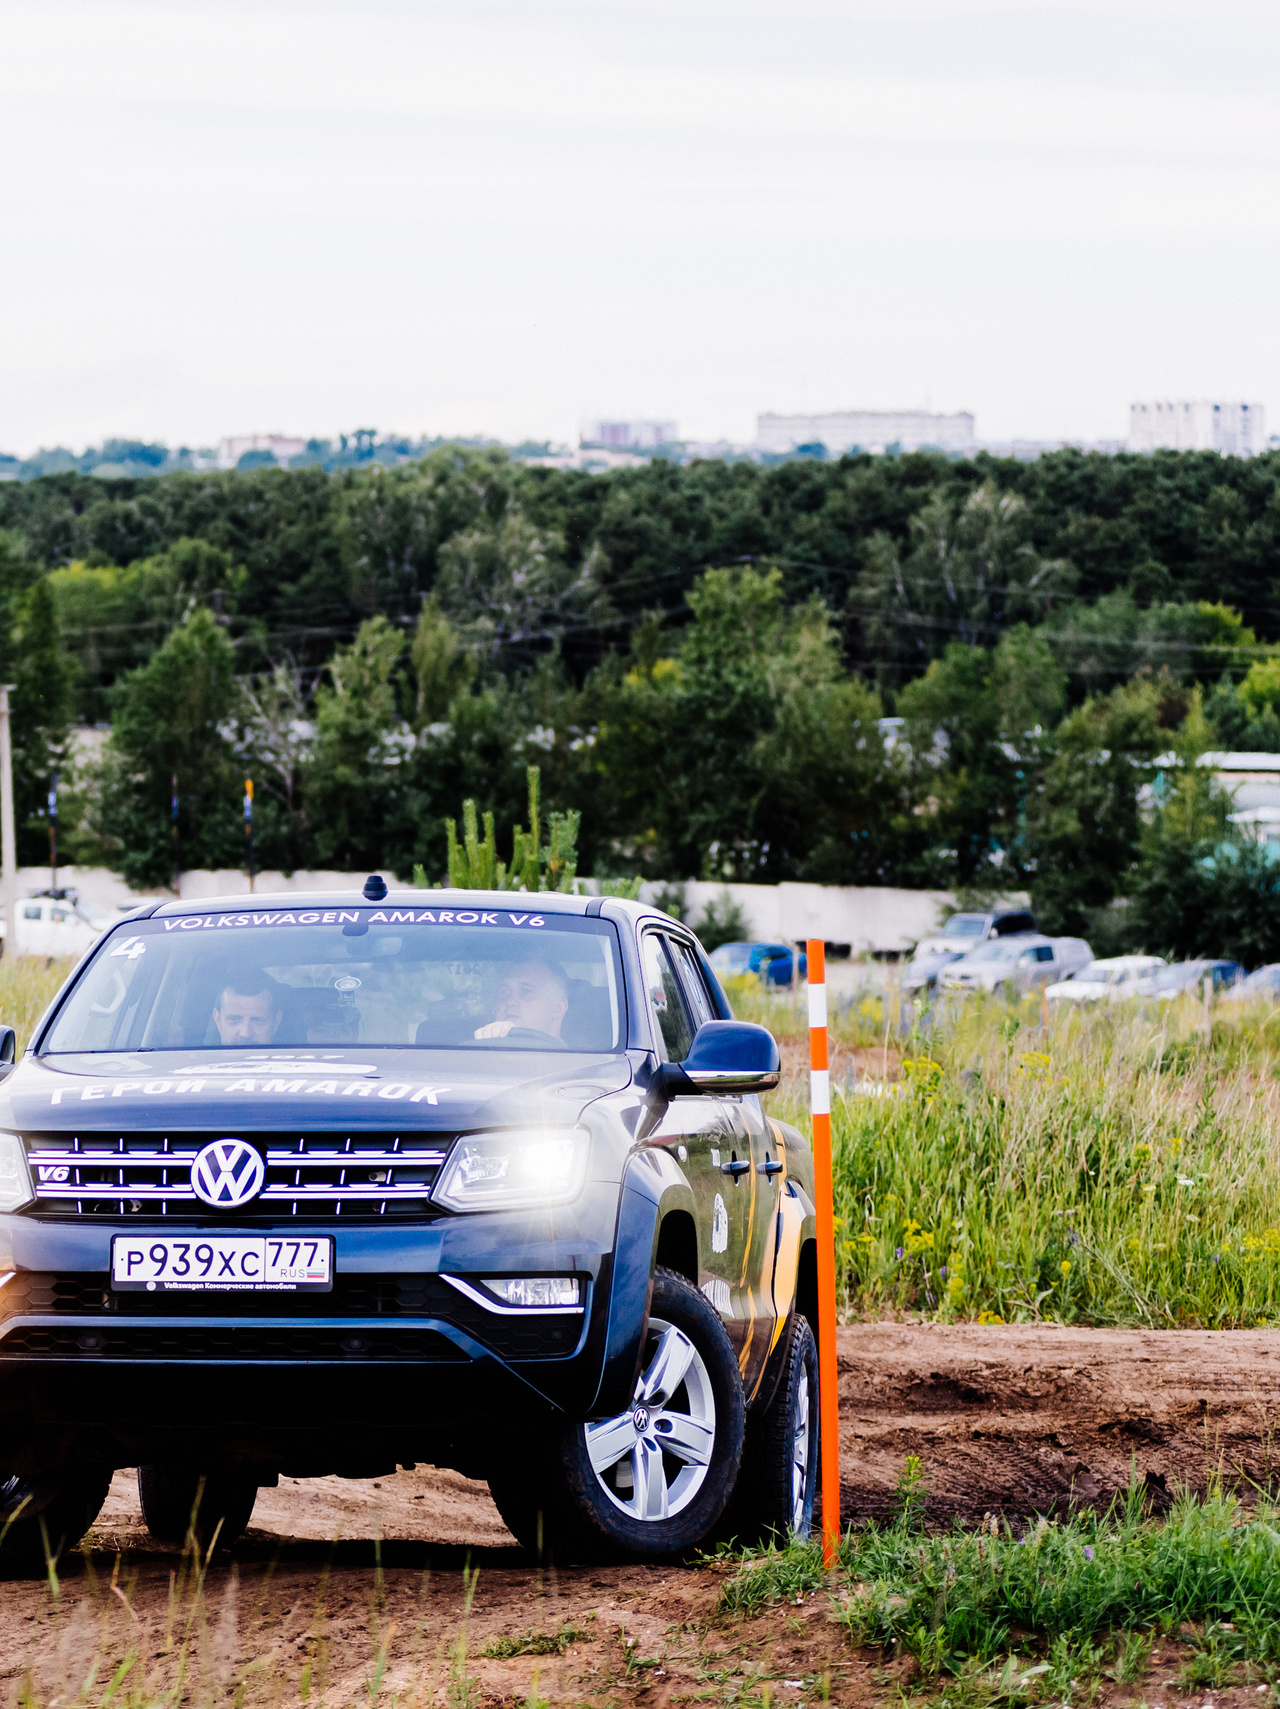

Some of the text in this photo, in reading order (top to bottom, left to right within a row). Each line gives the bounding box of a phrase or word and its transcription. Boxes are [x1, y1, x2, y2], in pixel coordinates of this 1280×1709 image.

[163, 911, 546, 931] VOLKSWAGEN AMAROK V6
[110, 936, 147, 960] 4
[224, 1077, 454, 1106] AMAROK
[38, 1165, 70, 1182] V6
[268, 1241, 319, 1268] 777
[280, 1268, 306, 1279] RUS
[164, 1281, 205, 1291] Volkswagen
[205, 1282, 255, 1291] Коммерческие
[255, 1282, 297, 1291] автомобили
